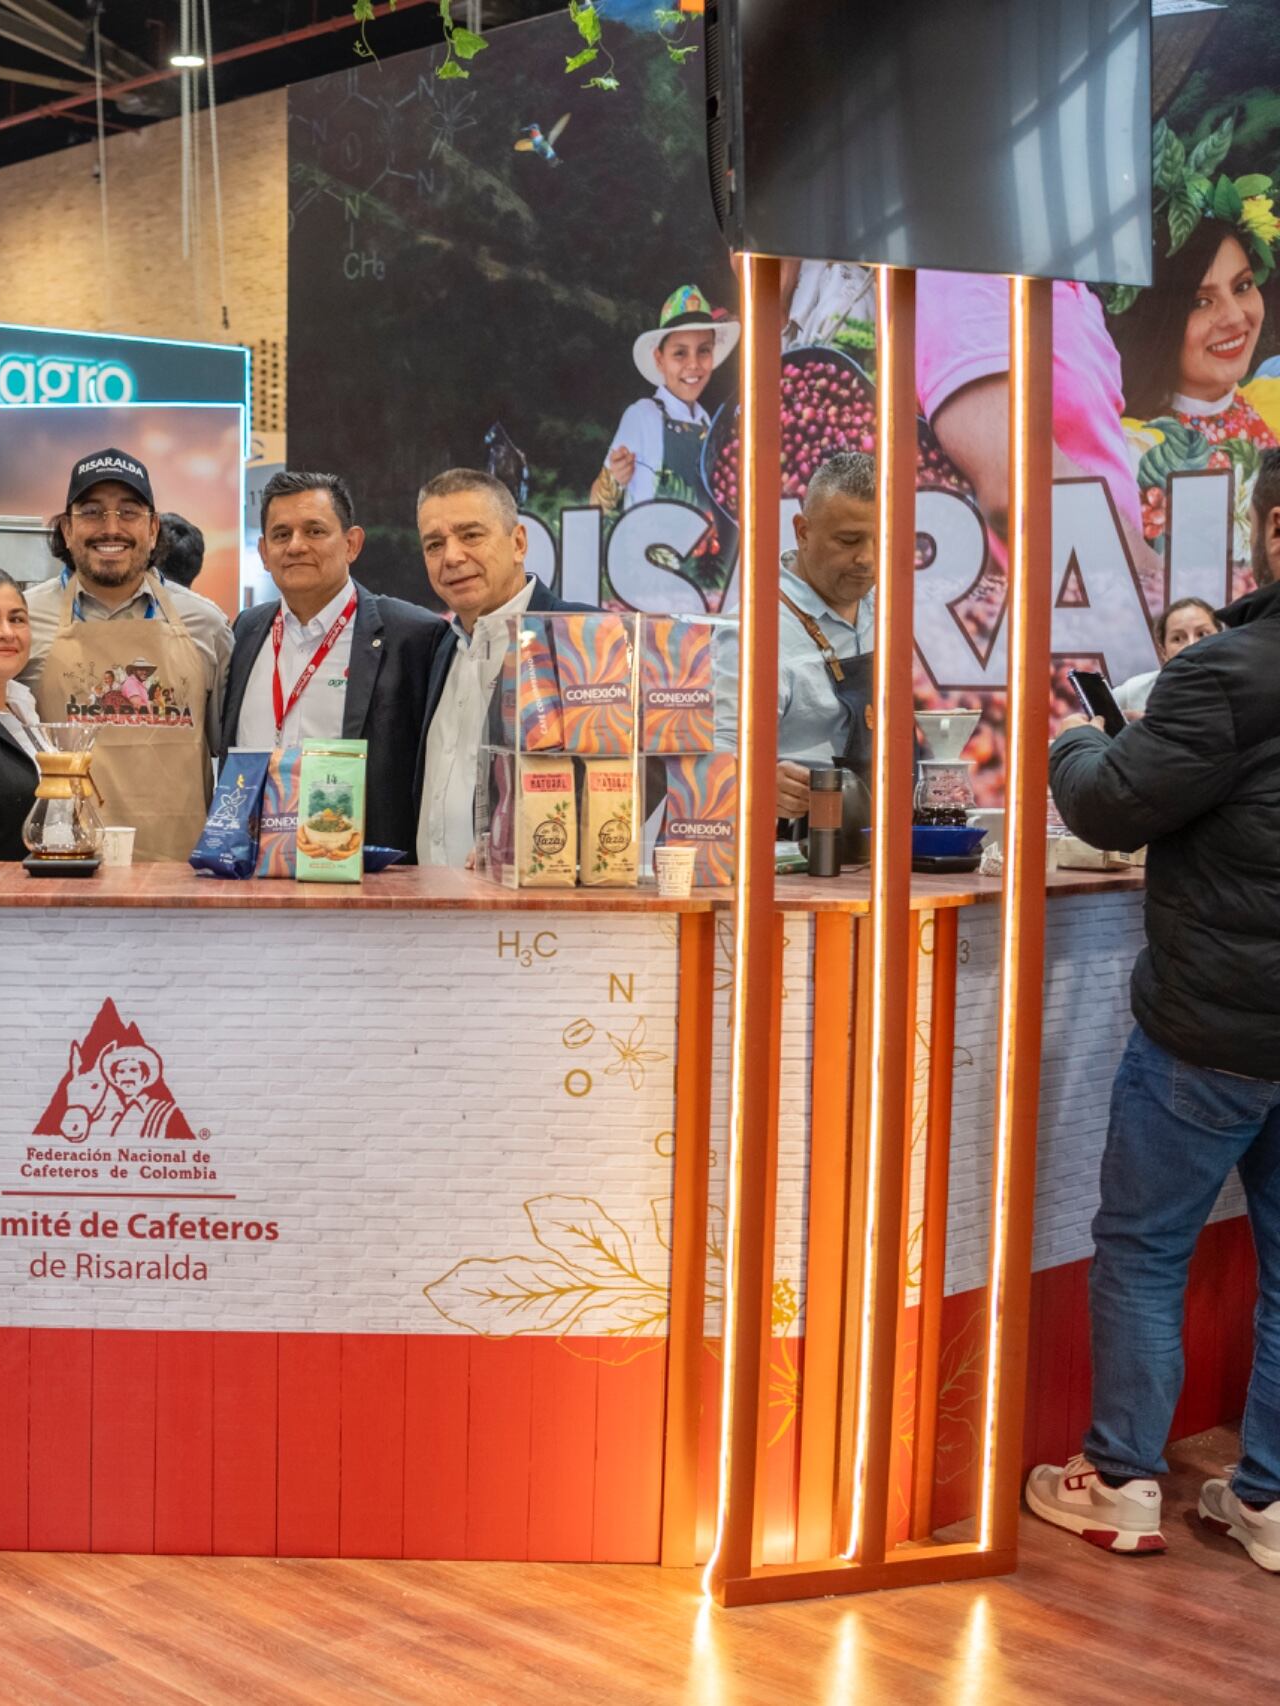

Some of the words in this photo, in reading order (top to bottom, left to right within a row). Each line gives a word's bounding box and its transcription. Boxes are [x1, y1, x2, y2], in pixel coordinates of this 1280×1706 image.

[78, 456, 145, 479] RISARALDA
[566, 685, 627, 701] CONEXIÓN
[649, 691, 710, 703] CONEXIÓN
[66, 702, 194, 728] RISARALDA
[671, 822, 732, 836] CONEXIÓN
[609, 973, 634, 1003] N
[564, 1069, 592, 1097] O
[26, 1147, 112, 1162] Federación
[118, 1148, 186, 1163] Nacional
[192, 1150, 211, 1163] de
[20, 1164, 99, 1178] Cafeteros
[110, 1165, 128, 1178] de
[140, 1166, 217, 1180] Colombia
[80, 1212, 118, 1238] de
[127, 1213, 280, 1241] Cafeteros
[29, 1251, 66, 1279] de
[76, 1253, 208, 1281] Risaralda
